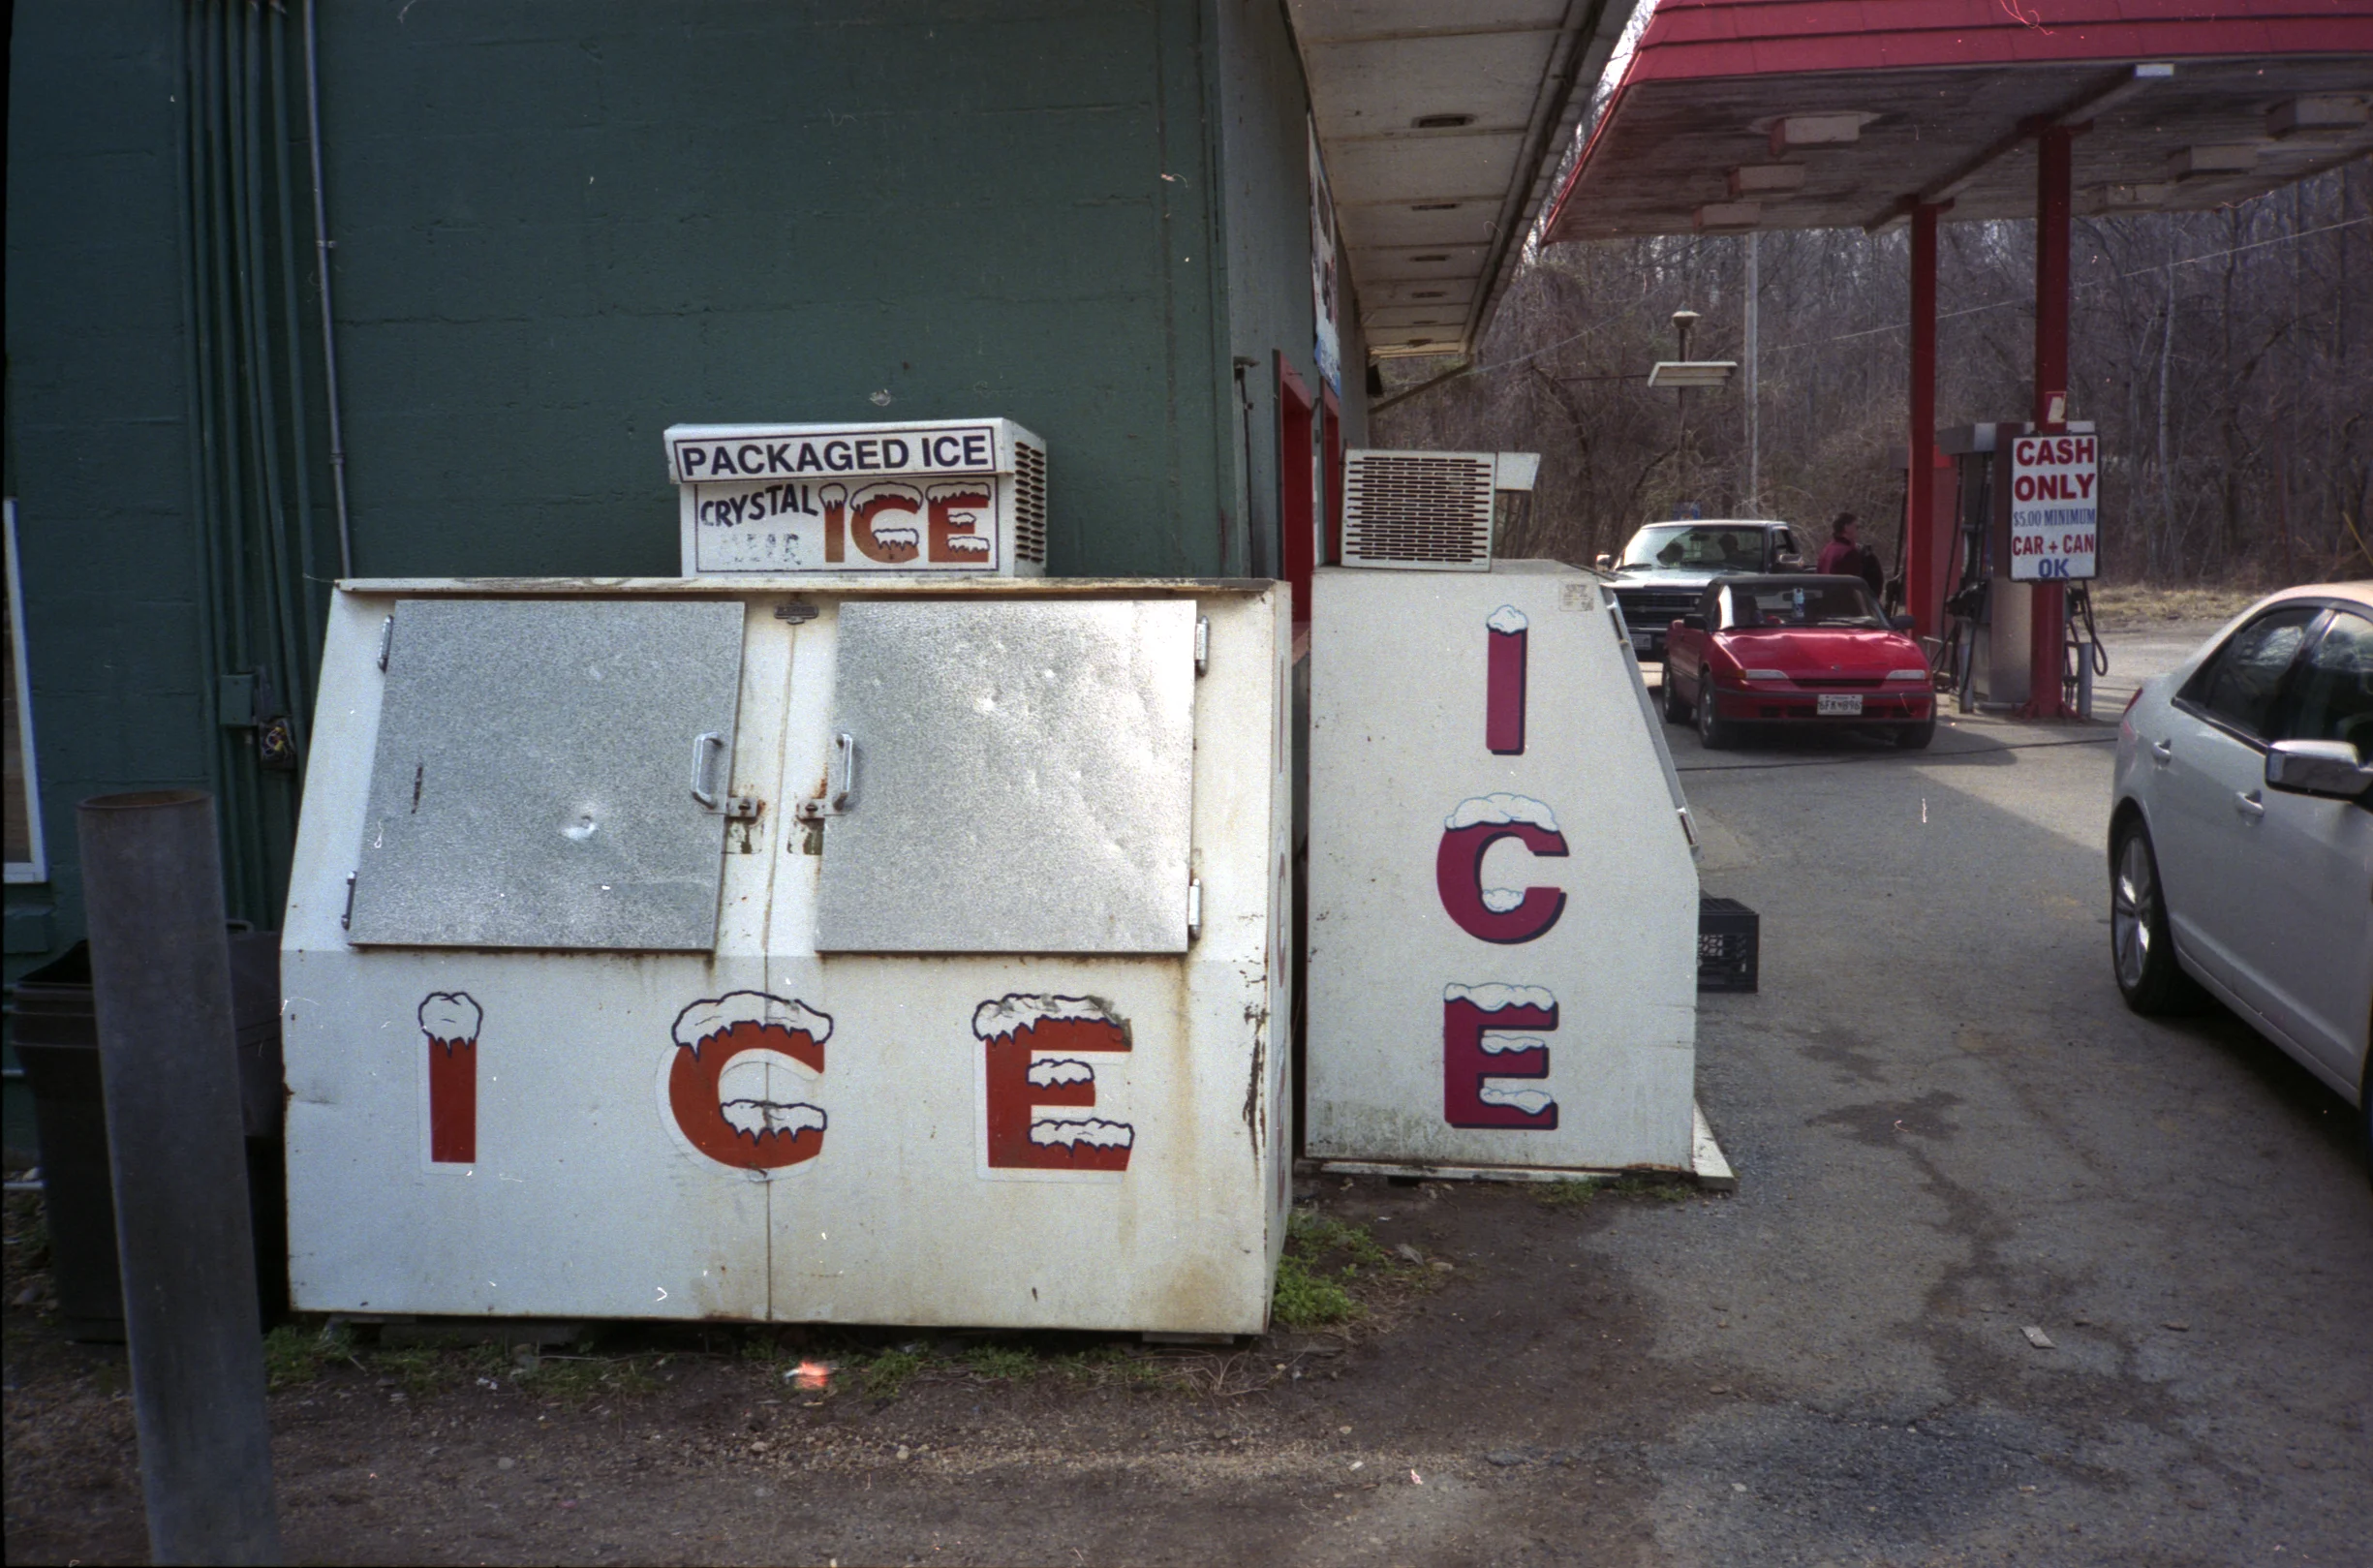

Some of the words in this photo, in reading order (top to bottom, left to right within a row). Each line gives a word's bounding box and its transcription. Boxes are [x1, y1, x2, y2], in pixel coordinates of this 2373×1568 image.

[681, 438, 909, 477] PACKAGED
[921, 435, 989, 468] ICE
[2016, 438, 2094, 466] CASH
[700, 484, 819, 527] CRYSTAL
[2014, 474, 2096, 502] ONLY
[818, 482, 991, 564] ICE
[2013, 511, 2041, 527] $5.00
[2044, 508, 2095, 527] MINIMUM
[2012, 536, 2044, 556] CAR
[2063, 534, 2094, 554] CAN
[2039, 558, 2069, 578] OK
[1436, 605, 1569, 1130] ICE
[418, 991, 1134, 1171] ICE
